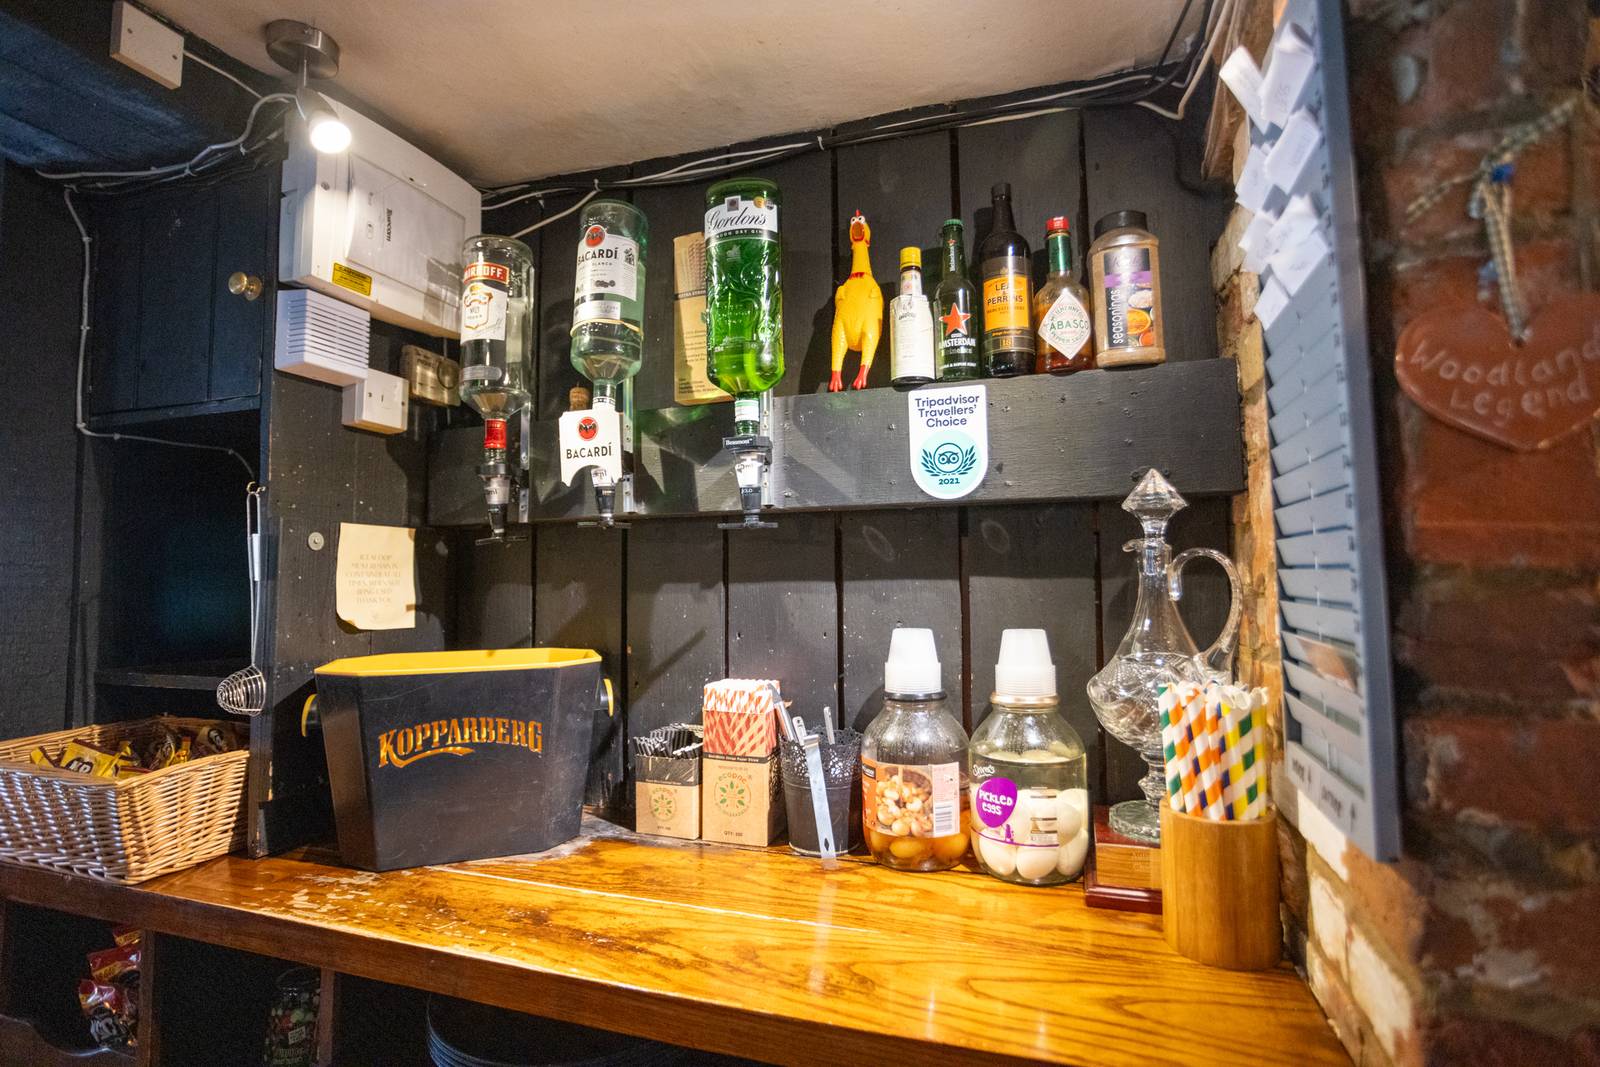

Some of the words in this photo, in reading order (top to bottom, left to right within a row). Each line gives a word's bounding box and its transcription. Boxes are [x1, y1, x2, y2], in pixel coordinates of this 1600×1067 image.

[707, 206, 766, 230] Gordon's
[987, 295, 1024, 306] PERRNS
[1109, 289, 1124, 345] seasonings
[914, 394, 980, 409] Tripadvisor
[1450, 369, 1591, 427] Legend
[918, 404, 977, 418] Travellers'
[926, 416, 967, 428] Choice
[566, 442, 612, 459] BACARDÍ
[938, 477, 961, 485] 2021
[378, 717, 543, 768] KOPPARBERG
